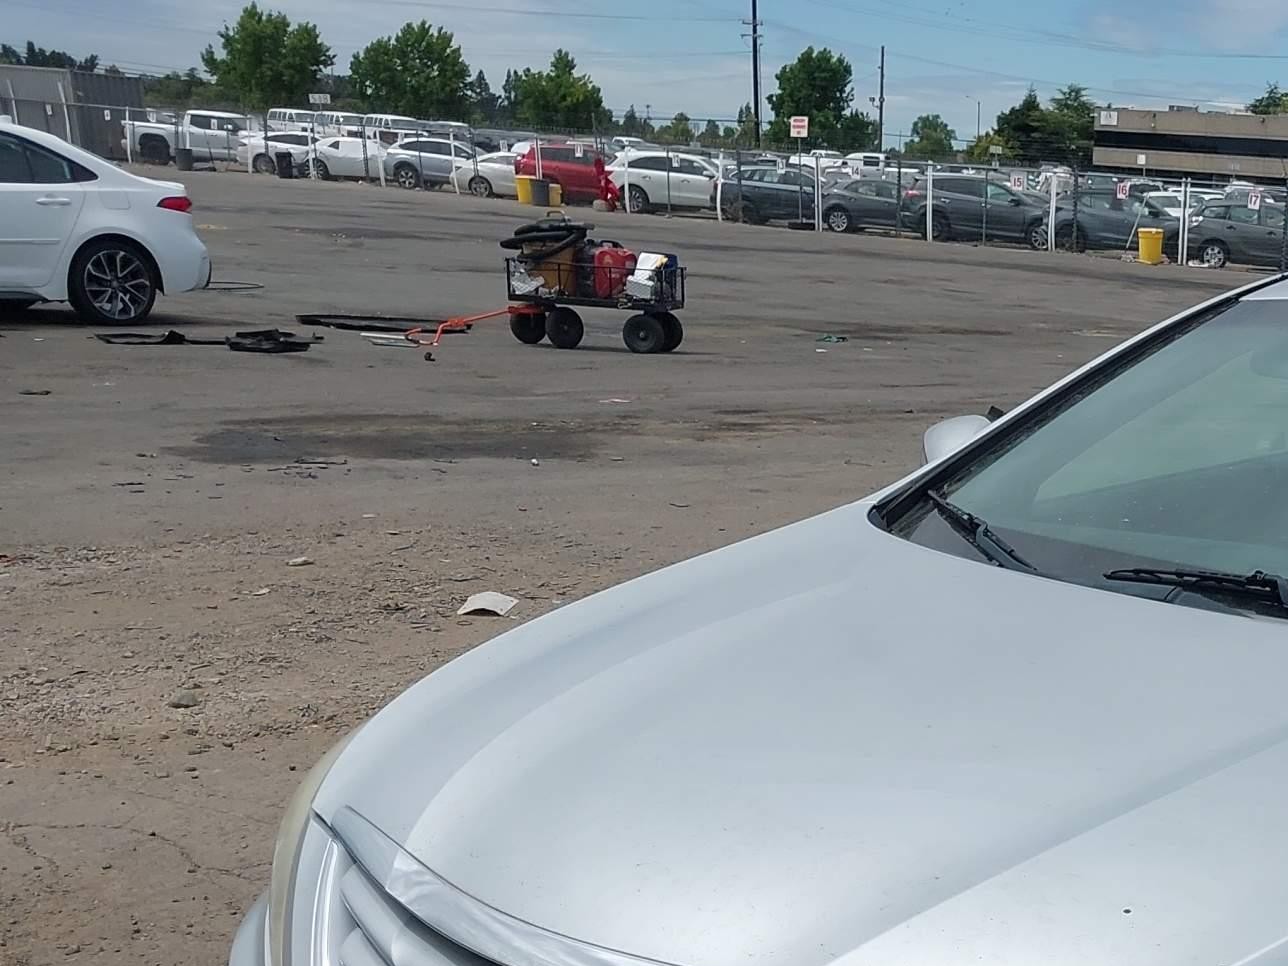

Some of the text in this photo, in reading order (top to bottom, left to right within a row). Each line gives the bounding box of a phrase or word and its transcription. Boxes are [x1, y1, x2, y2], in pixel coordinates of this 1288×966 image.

[1013, 177, 1022, 187] 15
[1118, 185, 1127, 196] 16
[1249, 194, 1259, 206] 17
